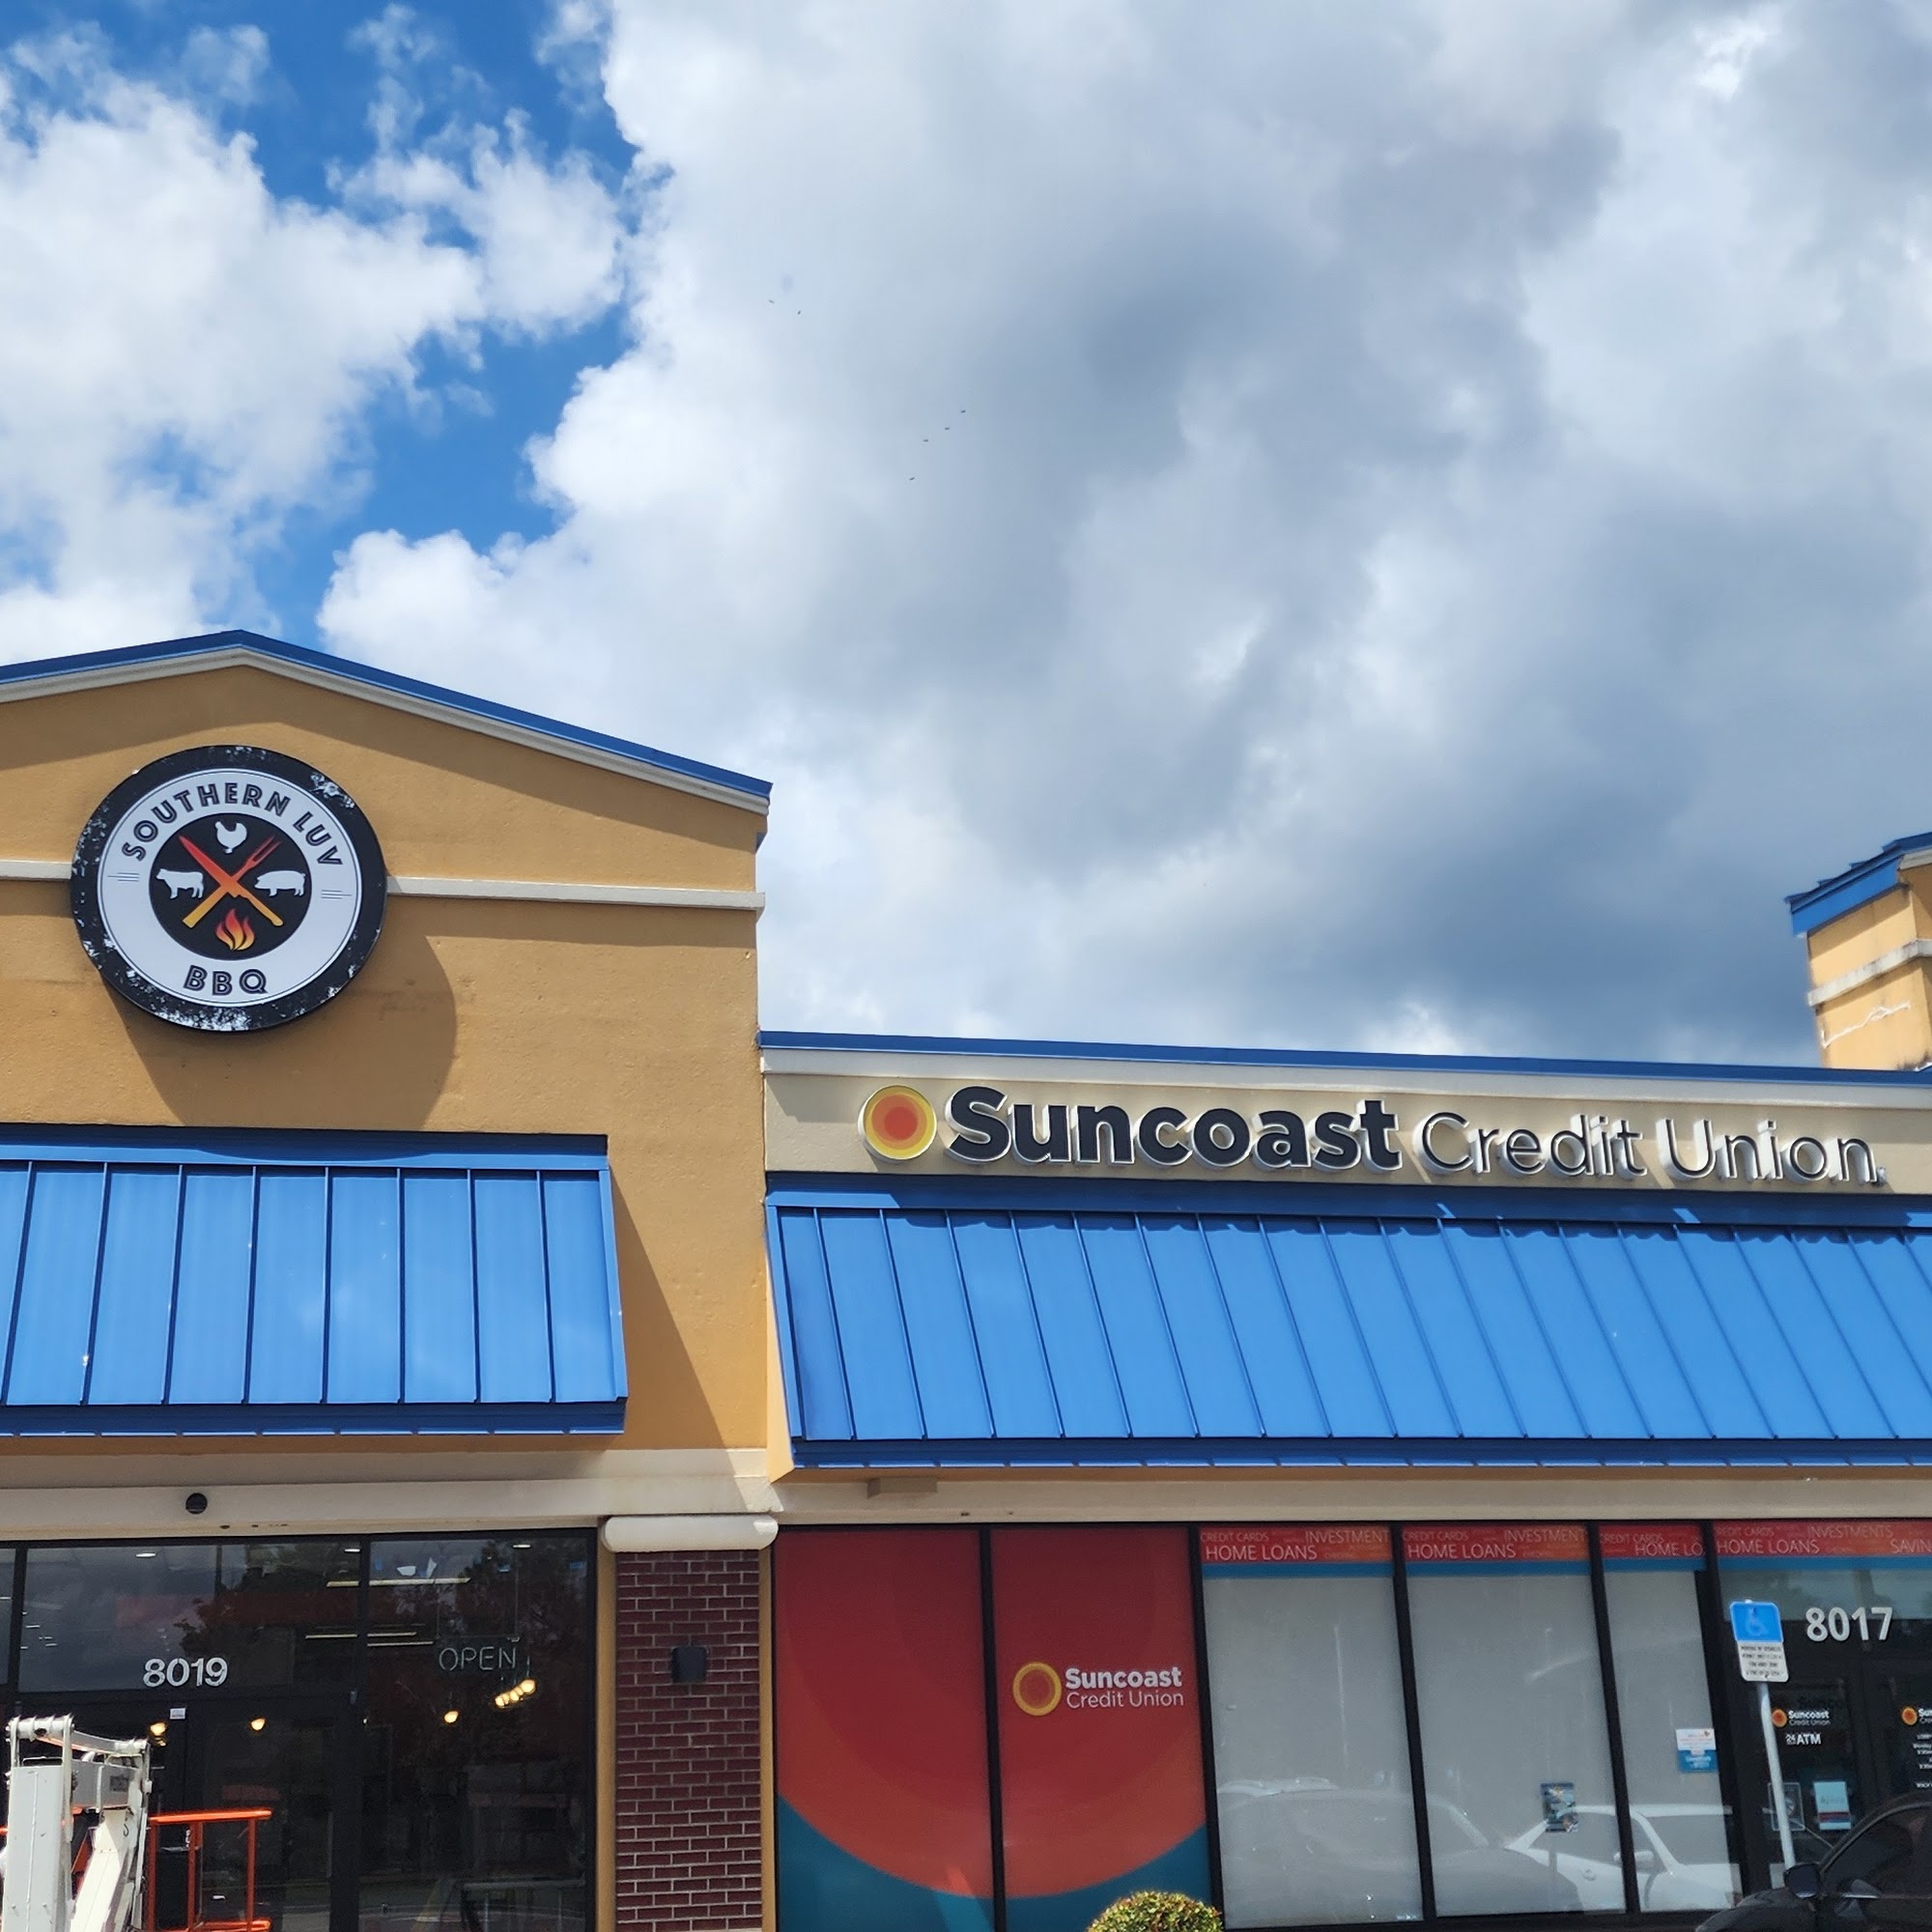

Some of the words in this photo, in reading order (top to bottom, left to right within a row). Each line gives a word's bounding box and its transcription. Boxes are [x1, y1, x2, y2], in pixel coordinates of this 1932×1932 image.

[122, 782, 291, 861] SOUTHERN
[293, 810, 343, 867] LUV
[184, 965, 268, 996] BBQ
[945, 1085, 1403, 1171] Suncoast
[1416, 1111, 1647, 1179] Credit
[1236, 1532, 1269, 1543] CARDS
[1504, 1529, 1589, 1543] INVESTMENT
[1807, 1524, 1893, 1538] INVESTMENTS
[1206, 1545, 1257, 1561] HOME
[1262, 1545, 1318, 1561] LOANS
[1407, 1544, 1457, 1559] HOME
[1463, 1543, 1517, 1559] LOANS
[1634, 1543, 1679, 1556] HOME
[1684, 1542, 1705, 1556] LO
[1716, 1539, 1763, 1554] HOME
[1768, 1539, 1820, 1554] LOANS
[1805, 1606, 1892, 1642] 8017
[439, 1645, 518, 1672] OPEN
[143, 1657, 228, 1688] 8019
[1065, 1666, 1182, 1689] Suncoast
[1066, 1691, 1123, 1708] Credit
[1129, 1690, 1184, 1707] Union
[1788, 1710, 1830, 1719] Suncoast
[1797, 1733, 1822, 1746] ATM
